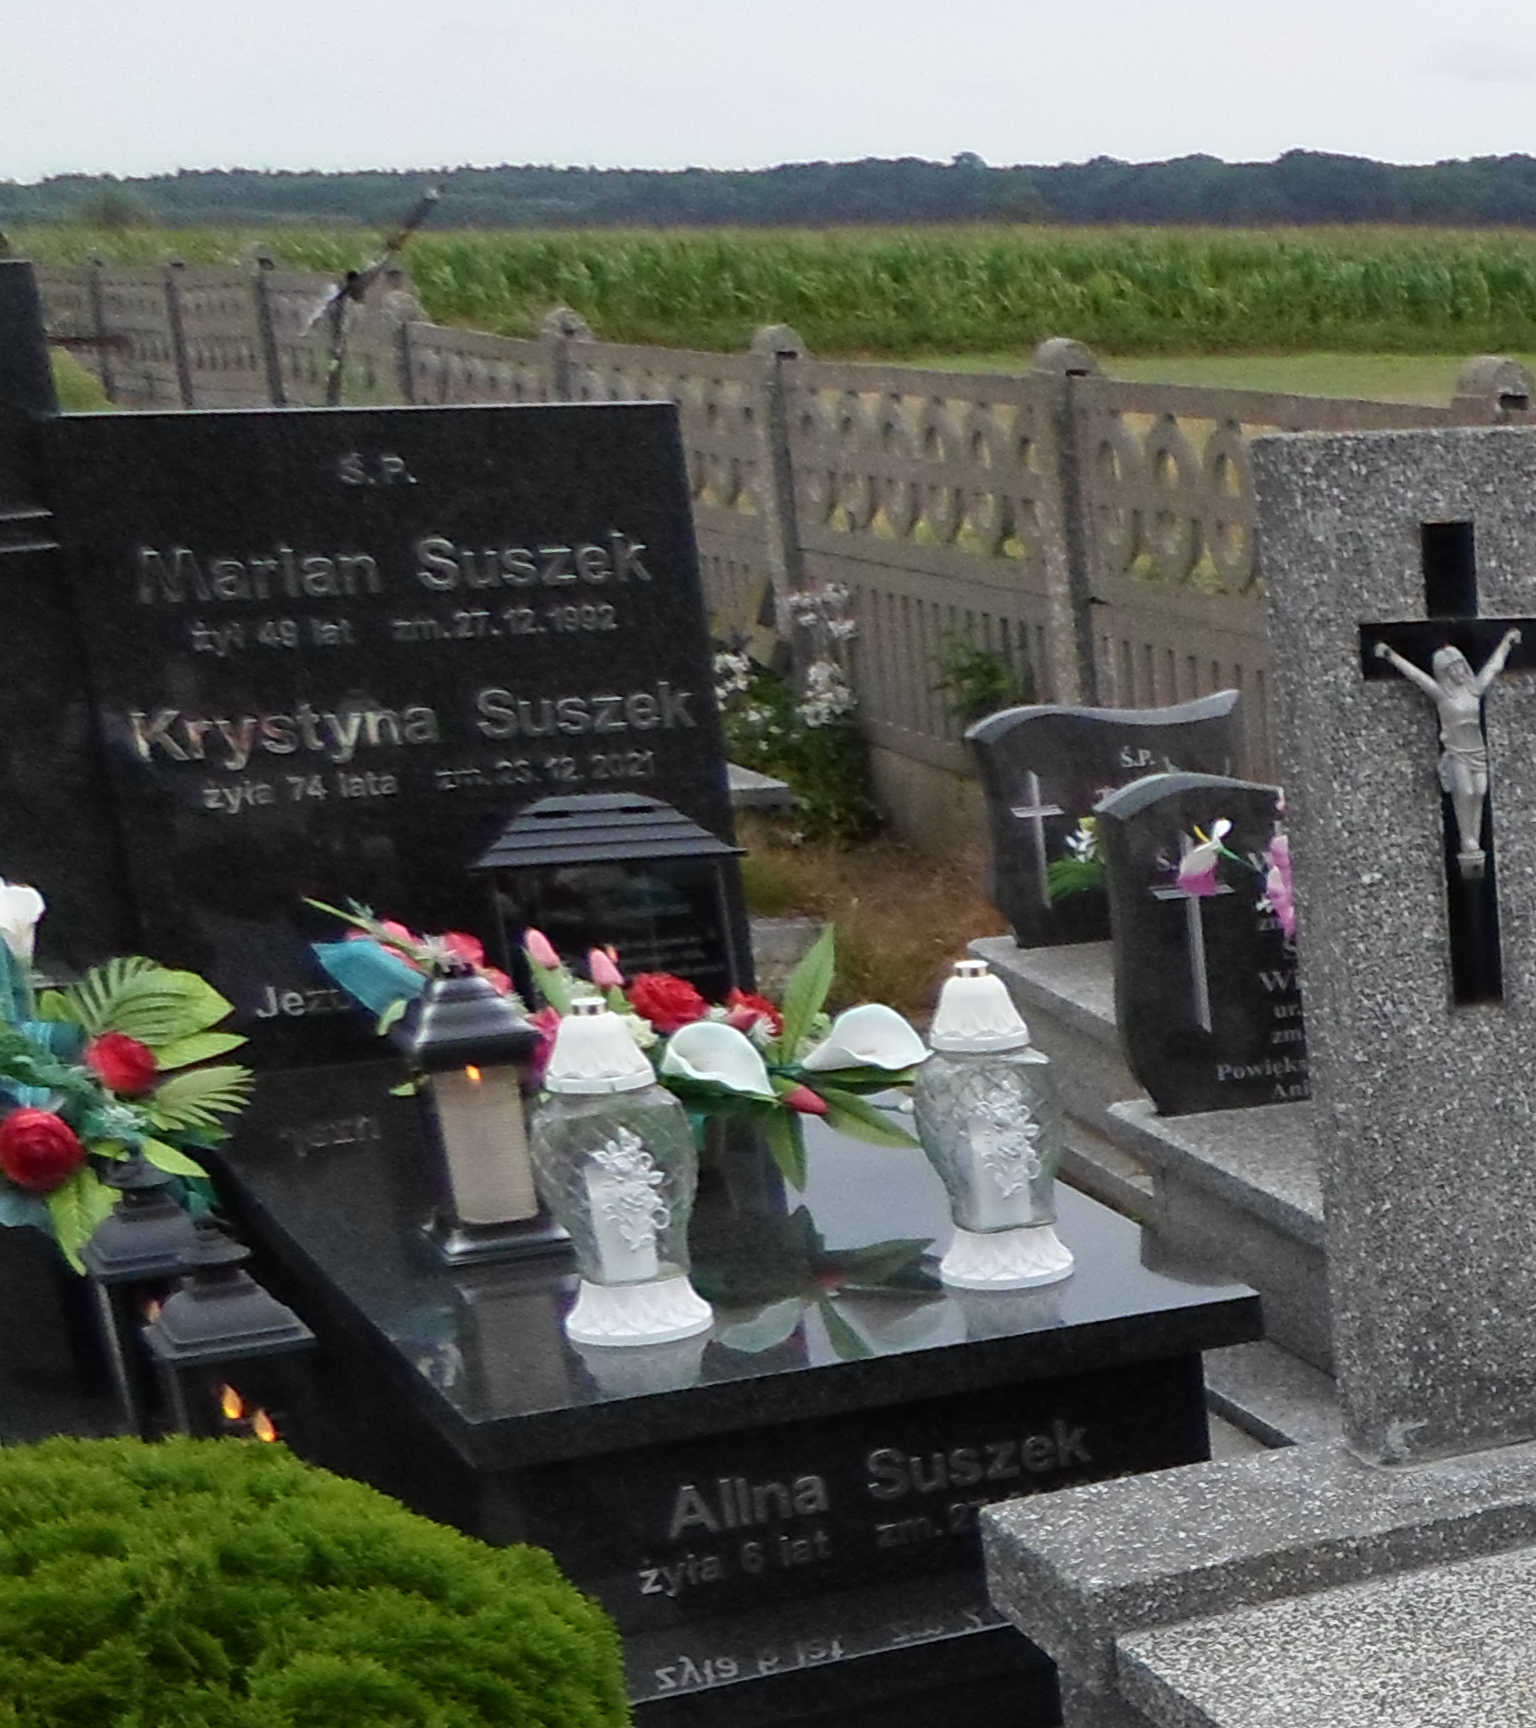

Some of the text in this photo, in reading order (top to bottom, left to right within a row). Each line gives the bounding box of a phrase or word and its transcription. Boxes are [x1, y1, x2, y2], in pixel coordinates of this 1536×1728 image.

[137, 529, 653, 604] Marian Suszek
[256, 618, 299, 649] 49
[310, 617, 356, 646] lat
[129, 680, 699, 771] Krystyna Suszek
[284, 774, 329, 802] 74
[336, 771, 400, 799] lata
[669, 1419, 1092, 1540] Alina Suszek
[740, 1540, 767, 1574] 6
[778, 1530, 832, 1567] lat
